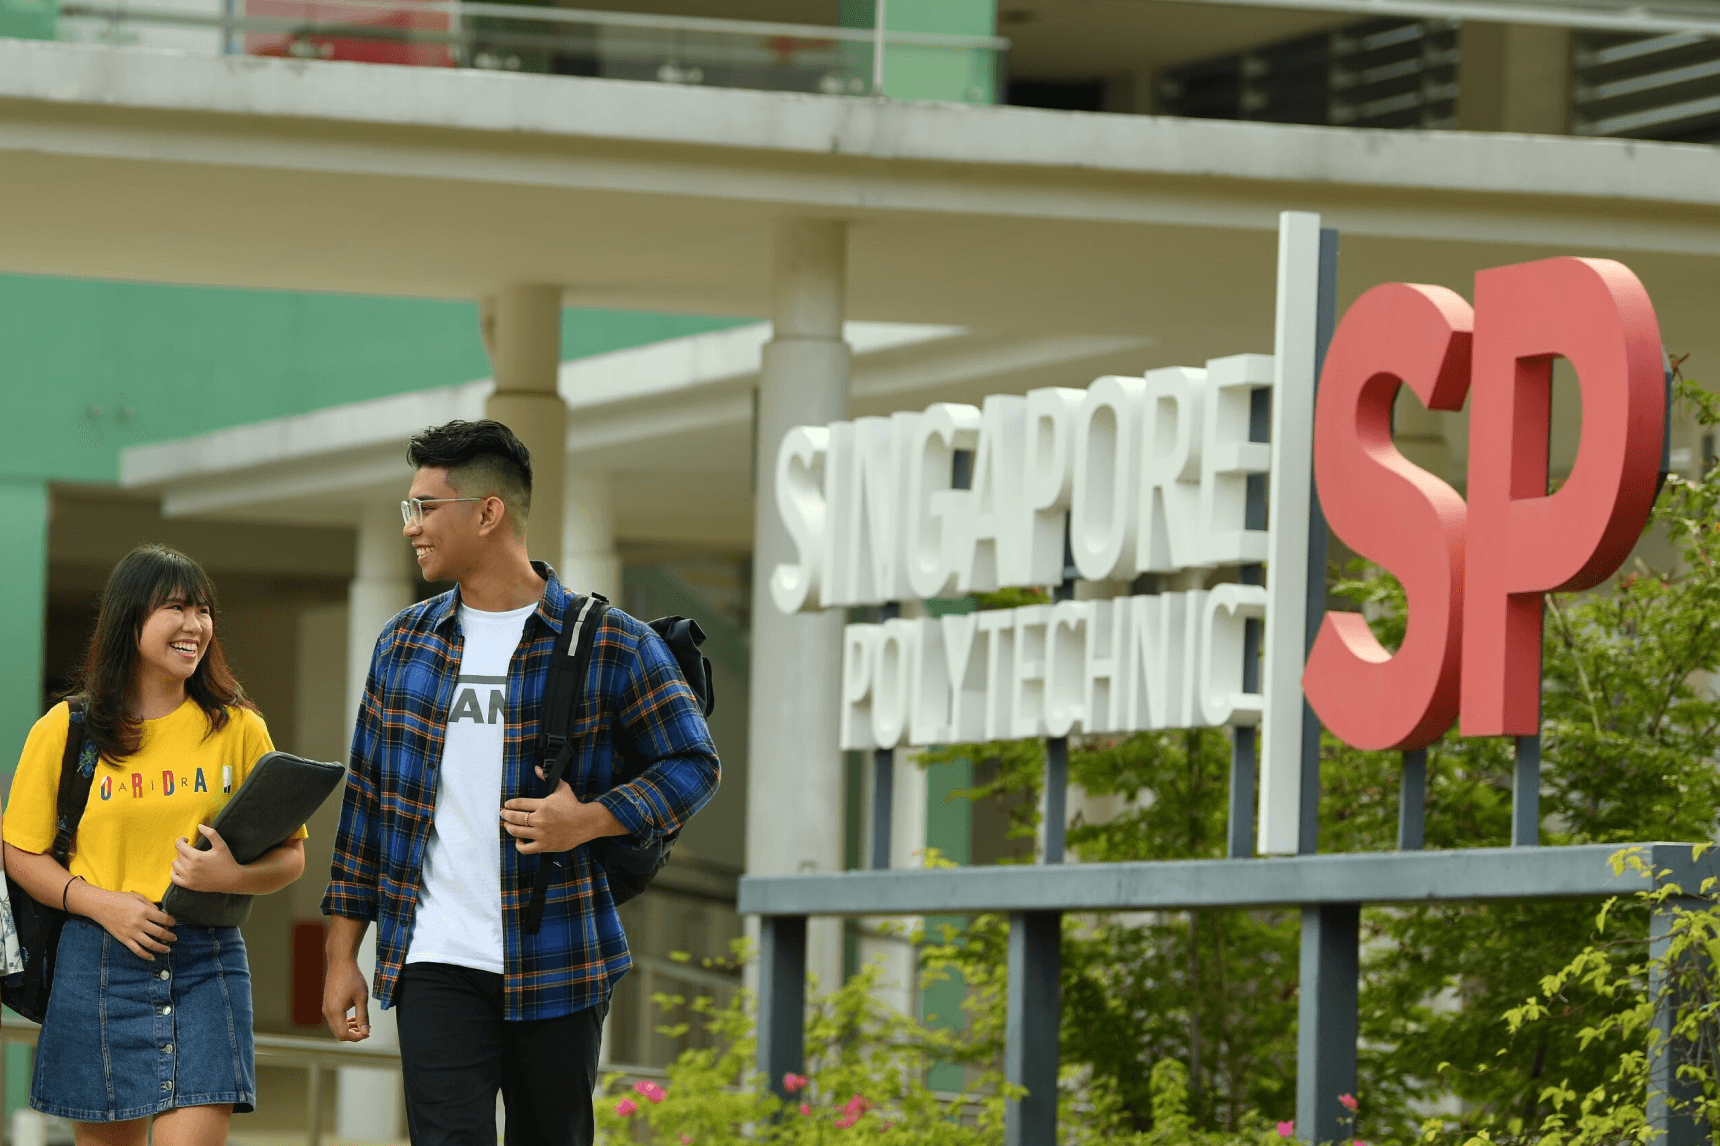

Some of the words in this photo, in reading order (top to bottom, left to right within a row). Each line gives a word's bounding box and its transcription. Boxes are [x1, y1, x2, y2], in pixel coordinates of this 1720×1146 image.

[770, 354, 1274, 614] SINGAPORE
[1301, 256, 1664, 751] SP
[840, 583, 1268, 751] POLYTECHNIC
